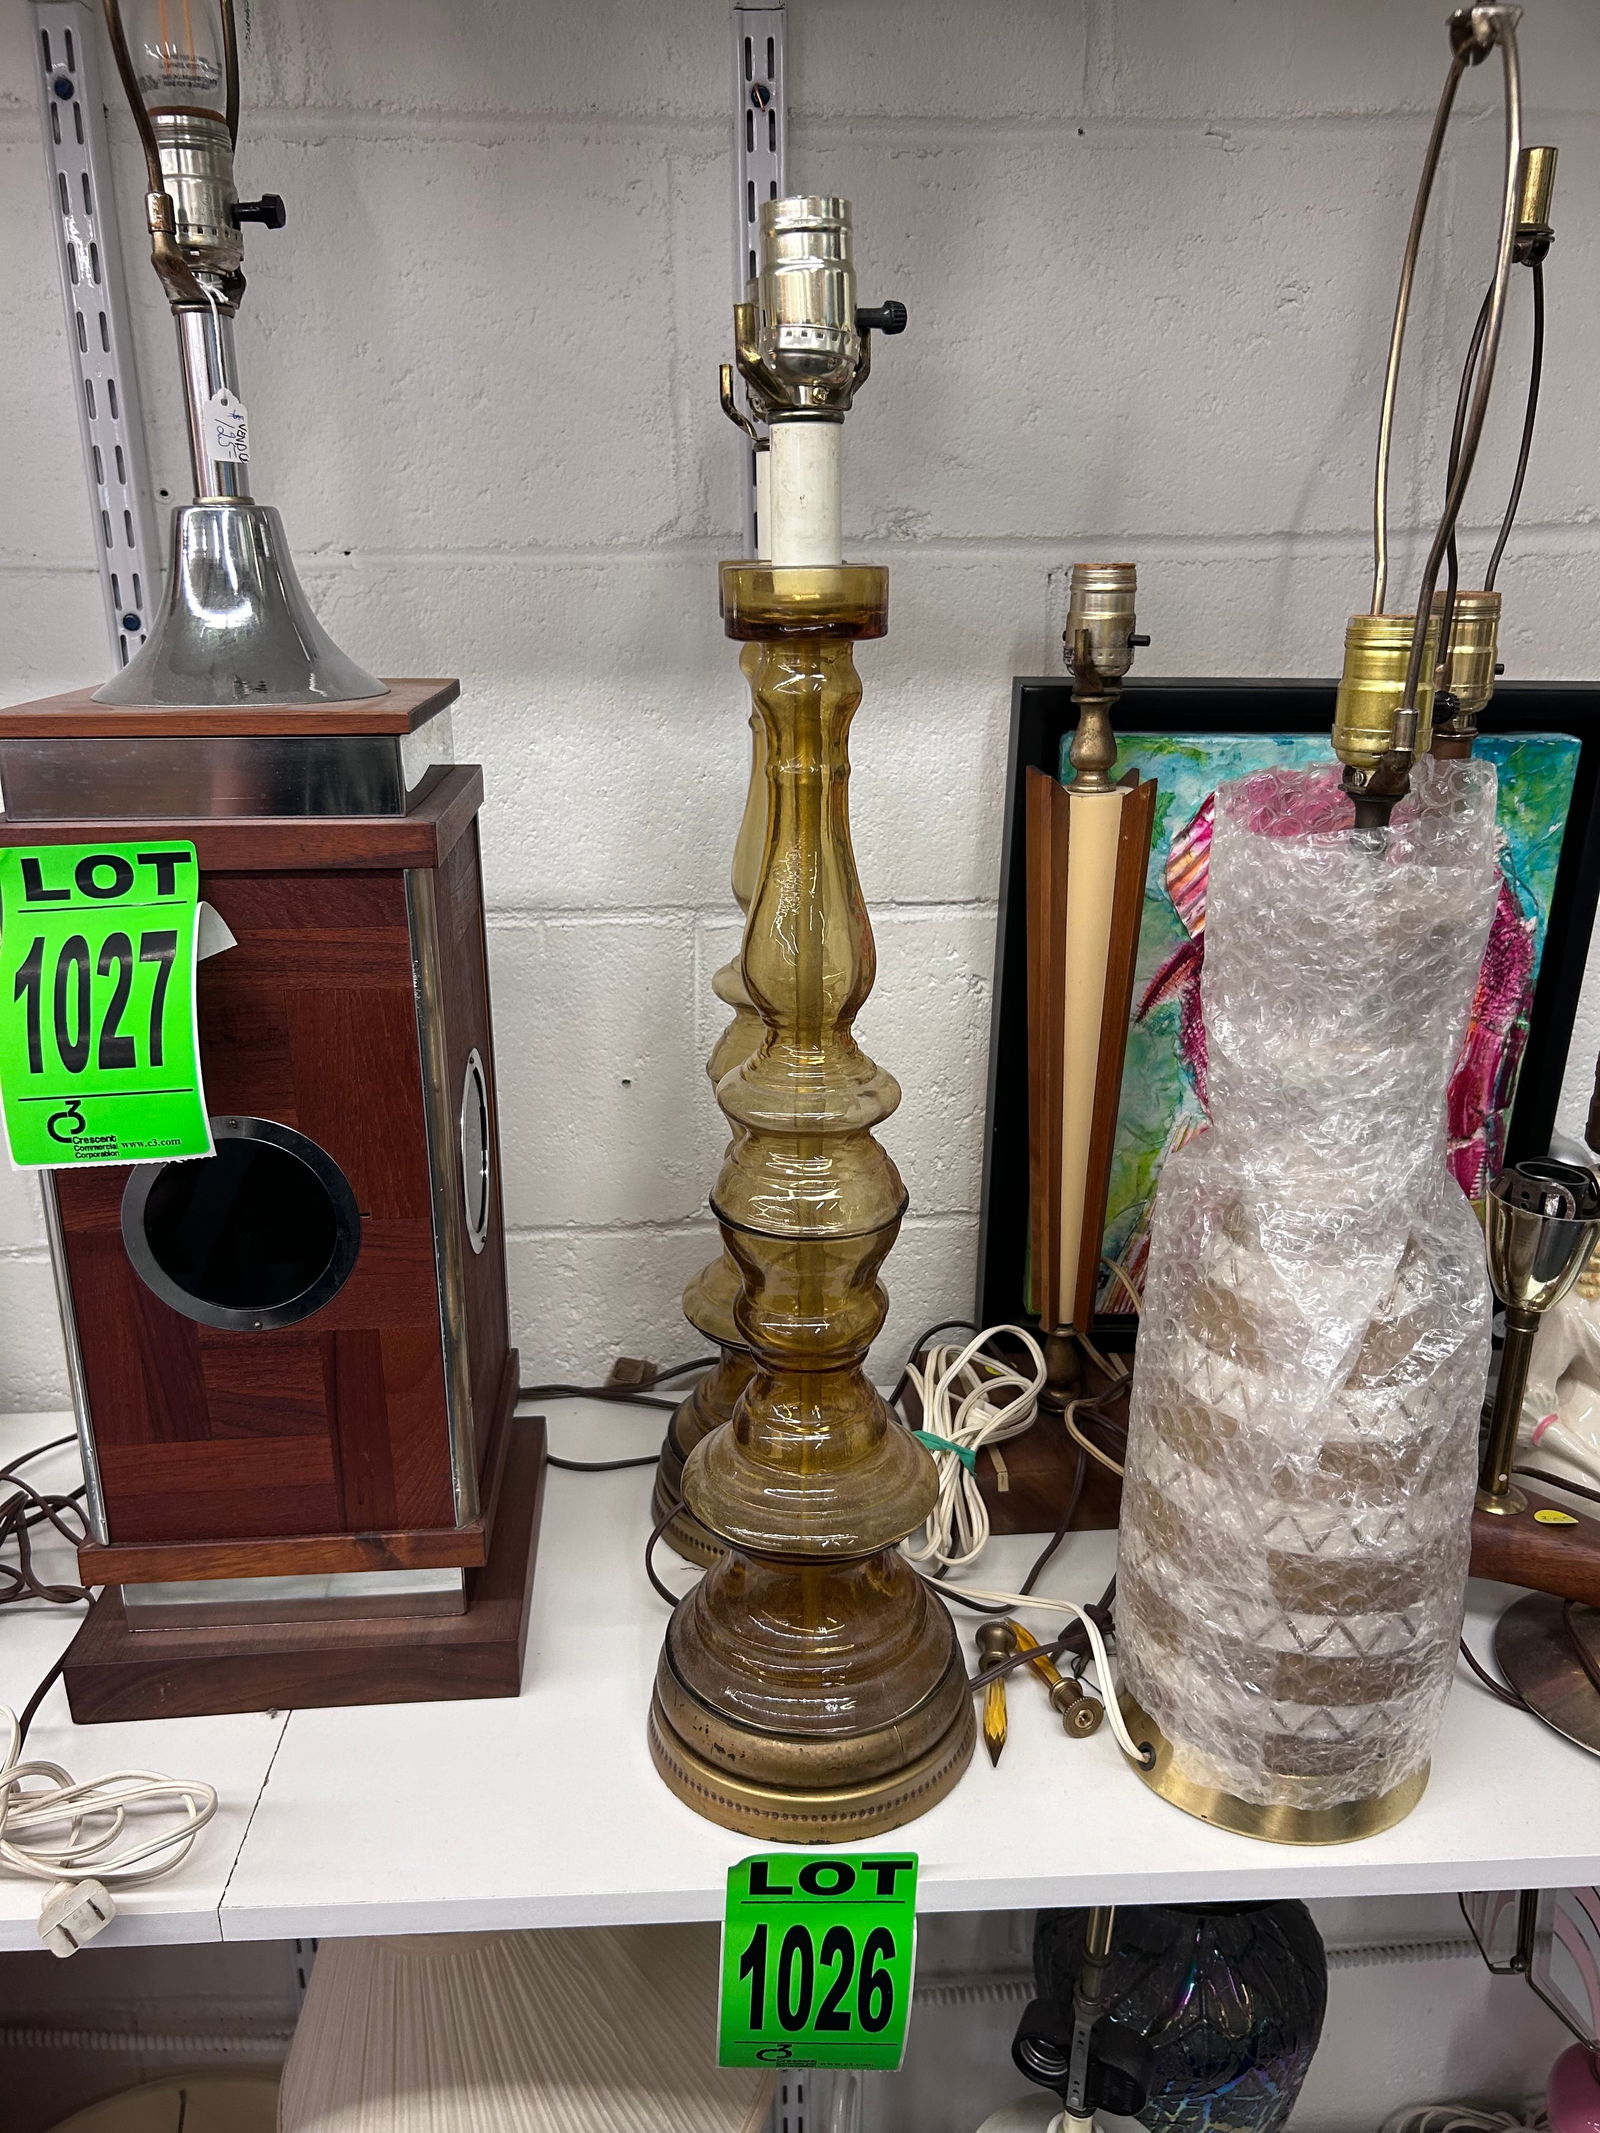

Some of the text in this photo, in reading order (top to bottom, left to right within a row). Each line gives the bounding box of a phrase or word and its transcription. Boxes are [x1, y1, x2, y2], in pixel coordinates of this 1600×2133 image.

[20, 851, 192, 902] LOT
[14, 930, 178, 1075] 1027
[72, 1134, 117, 1145] Crescent
[74, 1143, 118, 1152] Commercial
[121, 1138, 181, 1149] www.c3.com
[75, 1150, 120, 1159] Corporation
[749, 1861, 914, 1896] LOT
[739, 1923, 896, 2033] 1026
